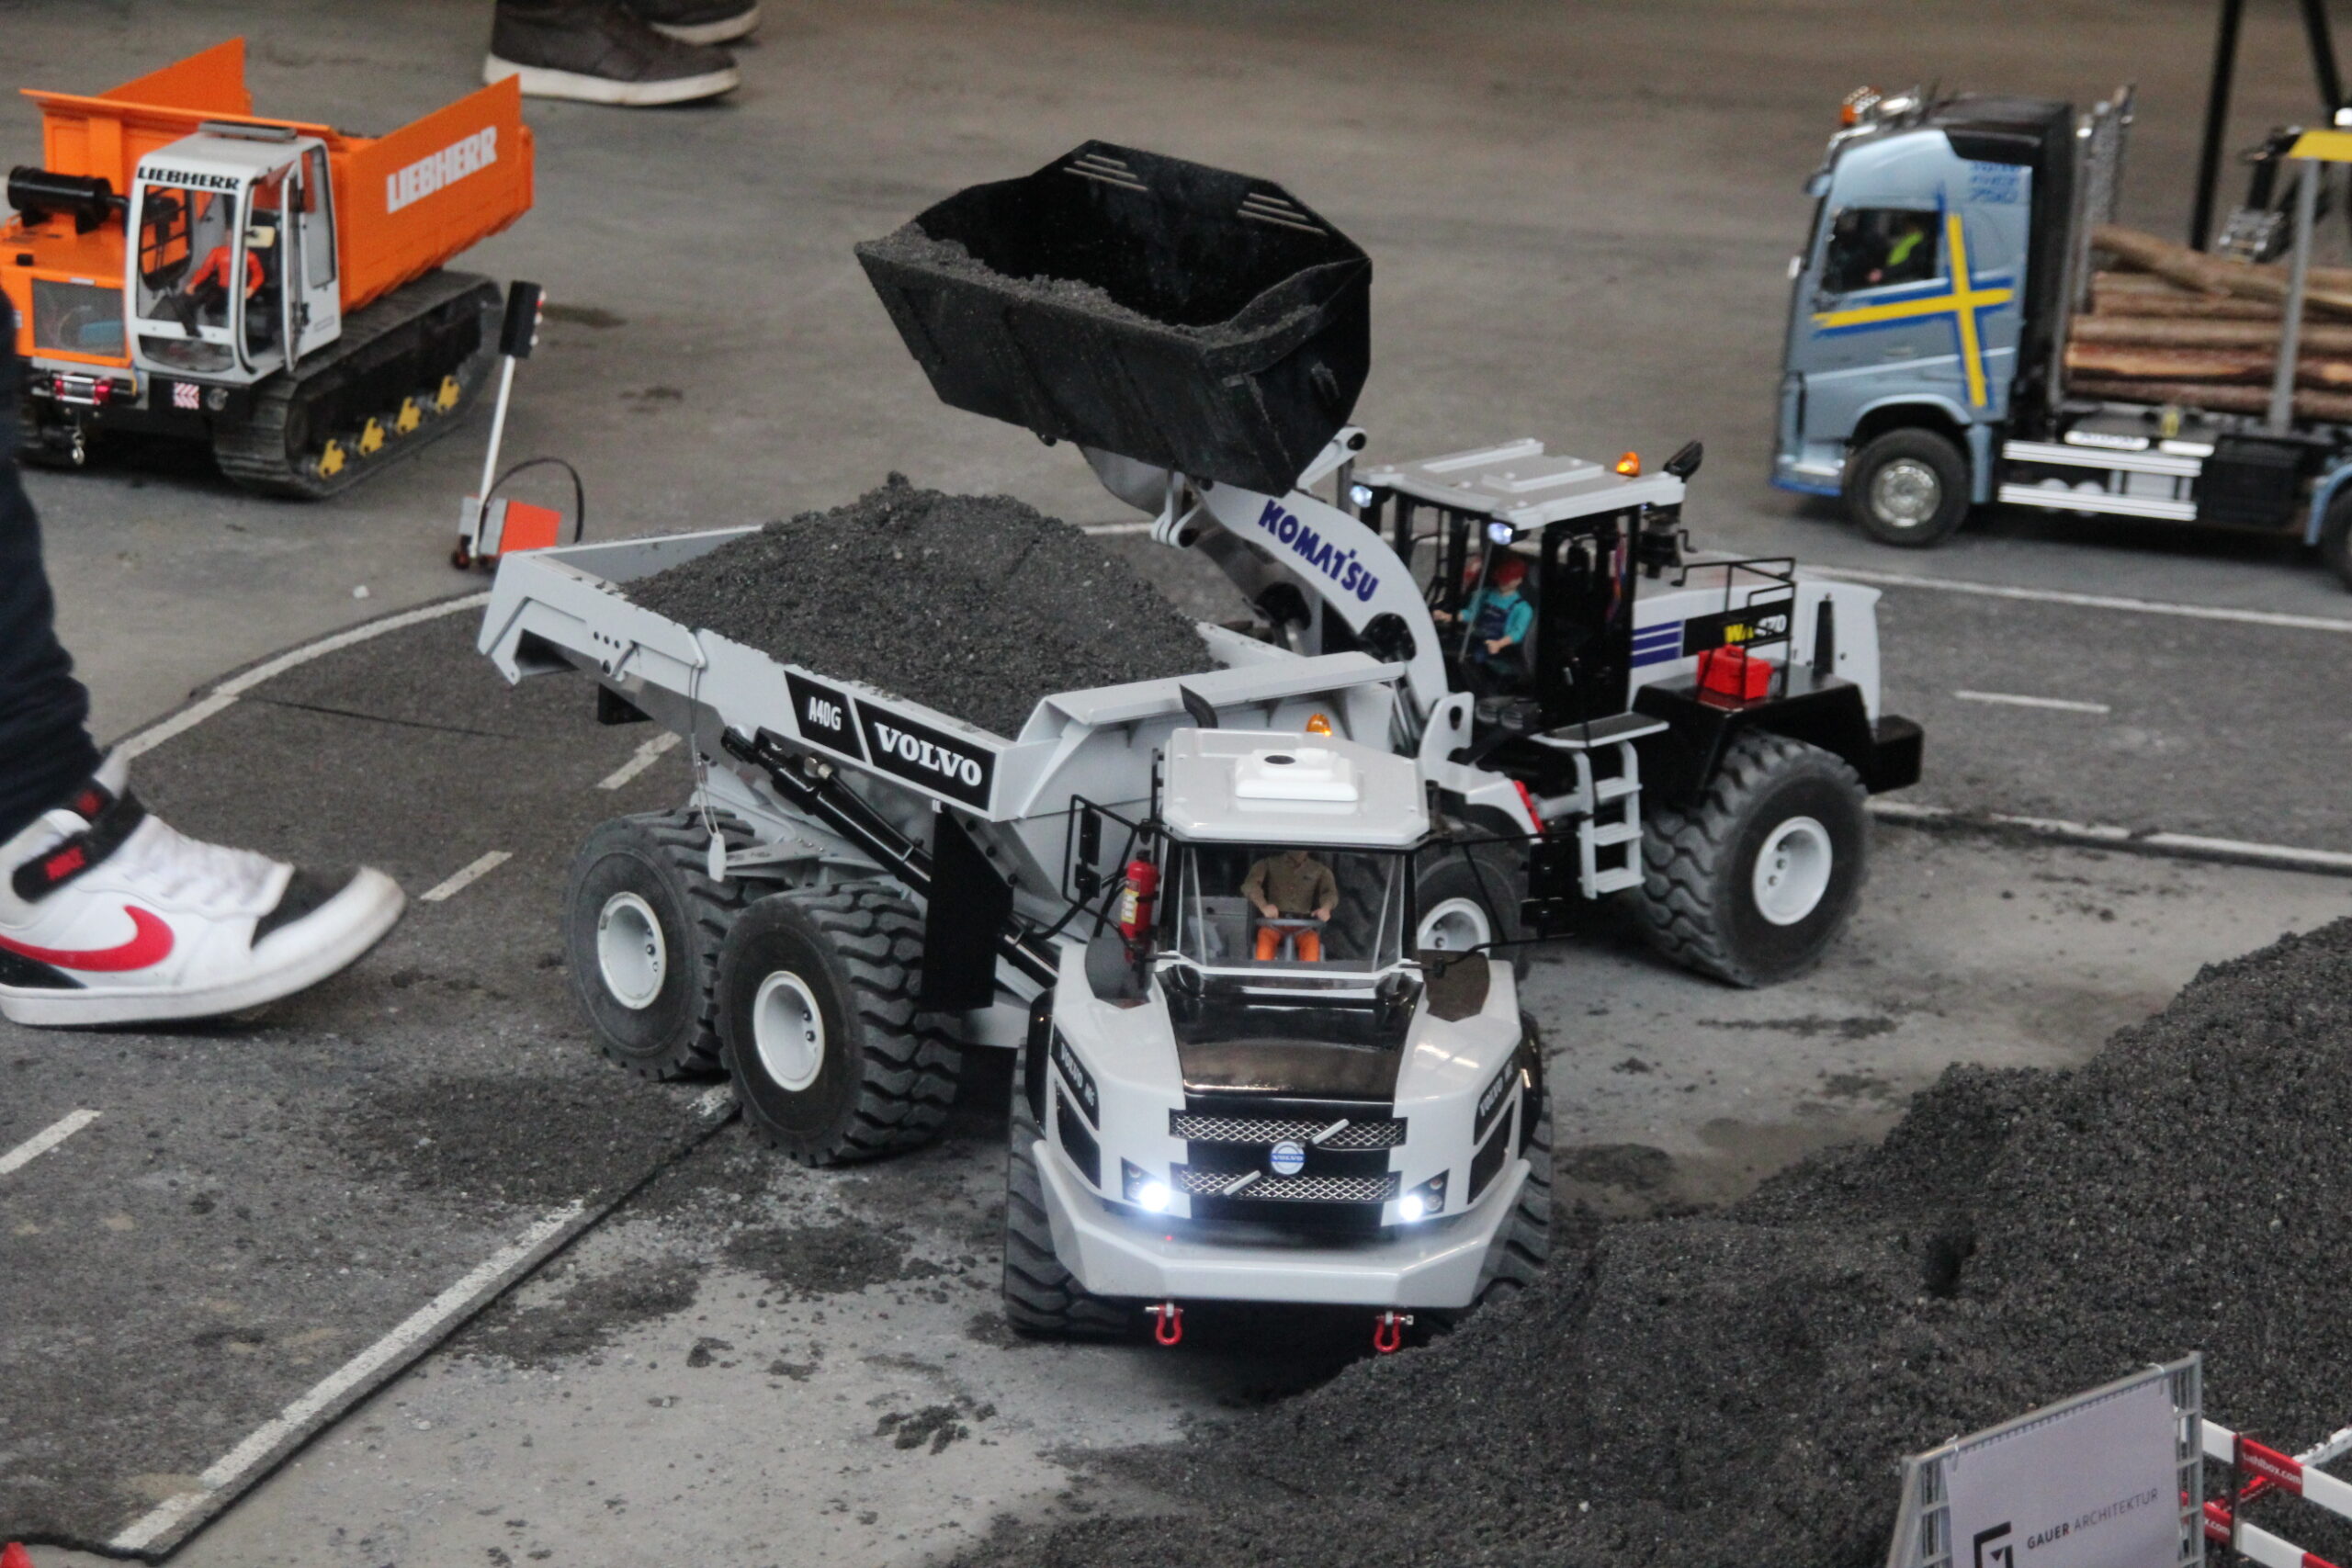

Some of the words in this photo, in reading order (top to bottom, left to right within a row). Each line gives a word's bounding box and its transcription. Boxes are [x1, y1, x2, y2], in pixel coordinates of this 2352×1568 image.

[137, 166, 240, 189] LIEBHERR
[387, 125, 497, 215] LIEBHERR
[1258, 499, 1380, 603] KOMATSU
[808, 696, 842, 732] A40G
[874, 721, 982, 787] VOLVO
[2027, 1522, 2070, 1550] GAUER
[2074, 1487, 2158, 1533] ARCHITEKTUR
